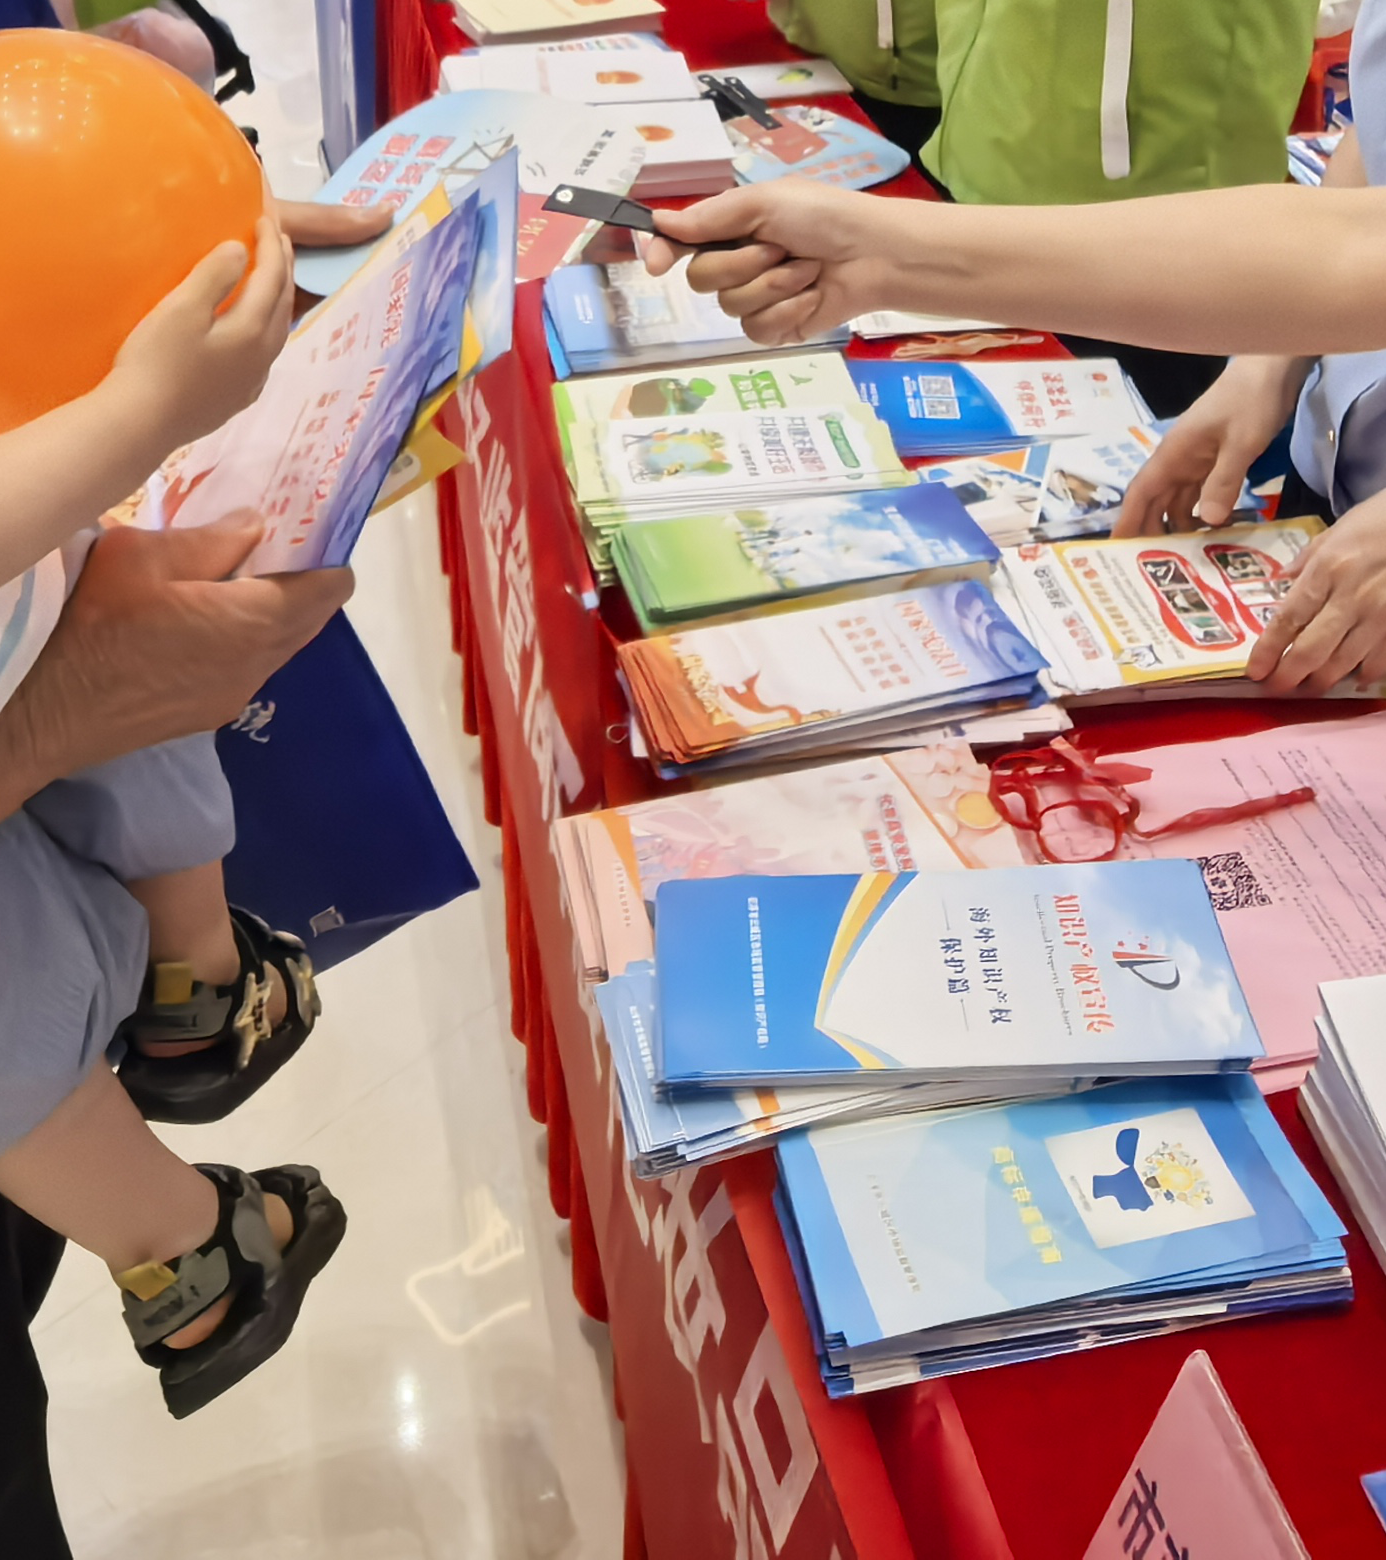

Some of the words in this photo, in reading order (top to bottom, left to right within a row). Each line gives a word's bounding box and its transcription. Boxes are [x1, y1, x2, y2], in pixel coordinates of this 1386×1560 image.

[938, 937, 971, 994] 保护篇
[968, 907, 1013, 1024] 海外知识产权
